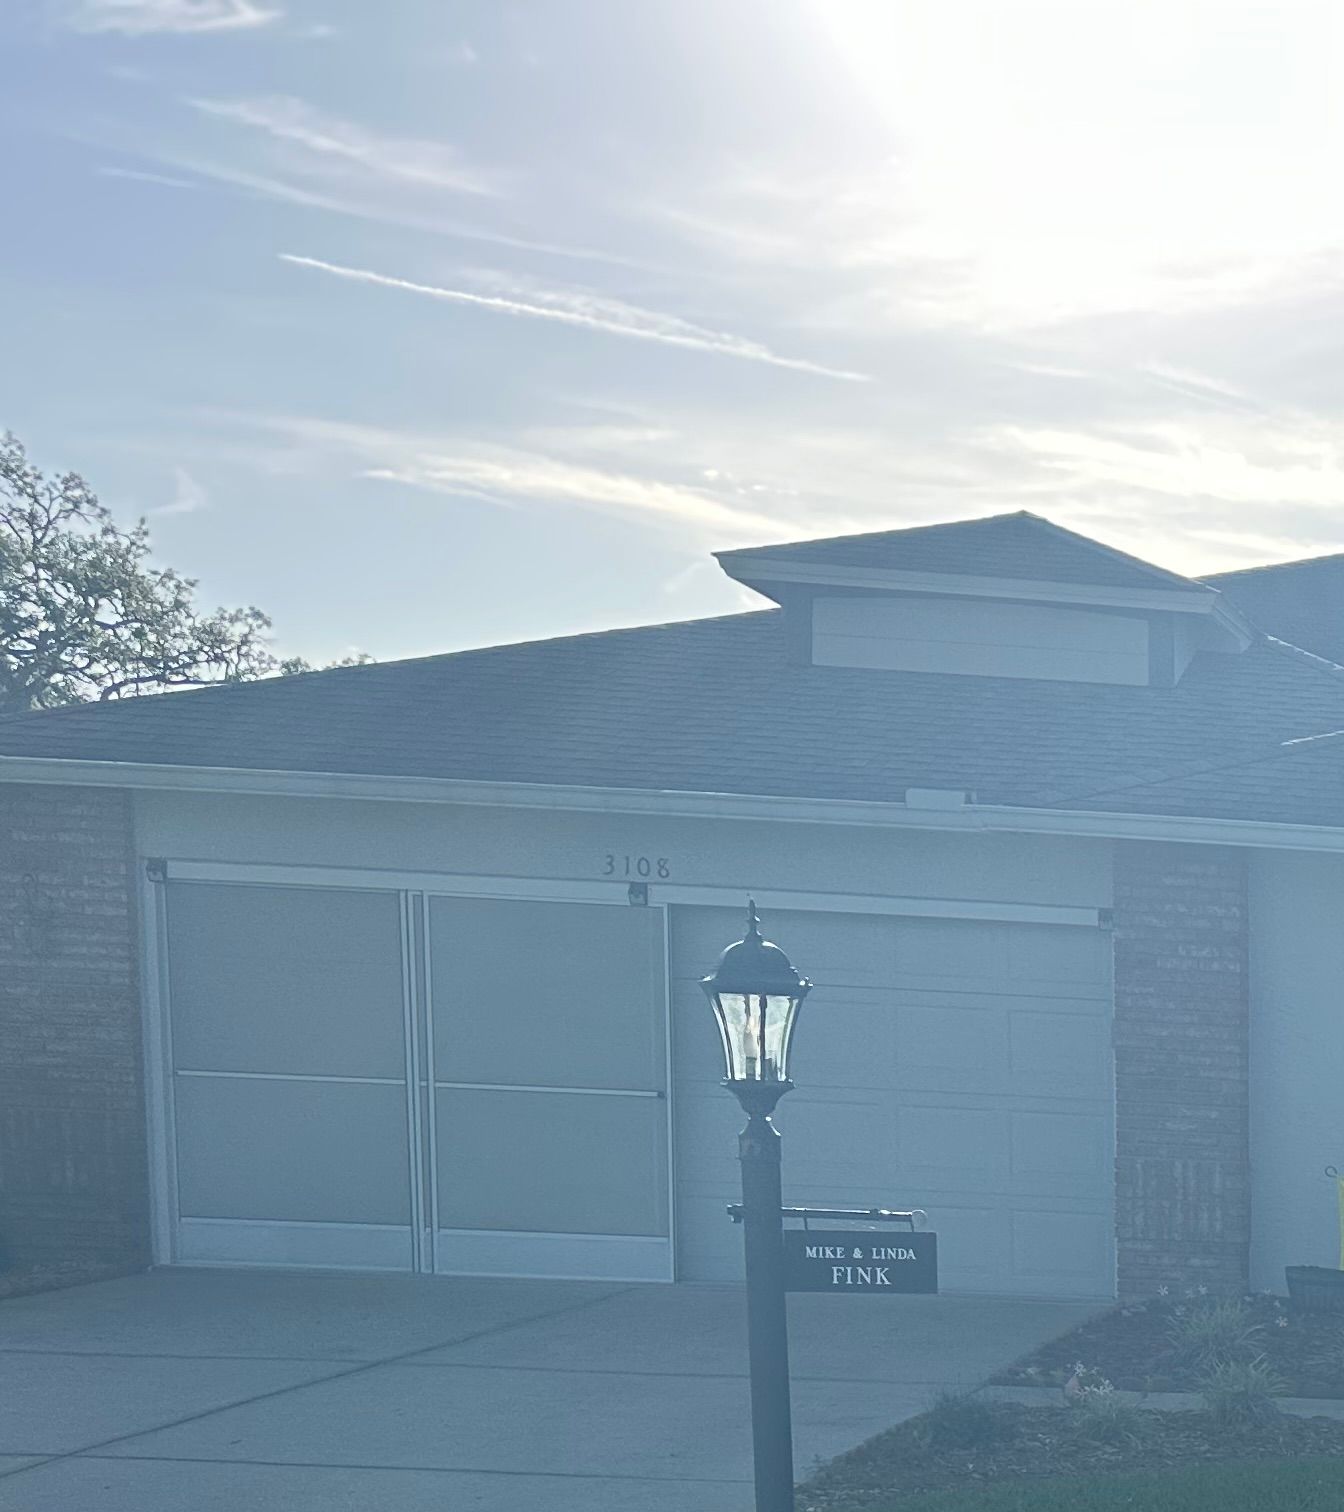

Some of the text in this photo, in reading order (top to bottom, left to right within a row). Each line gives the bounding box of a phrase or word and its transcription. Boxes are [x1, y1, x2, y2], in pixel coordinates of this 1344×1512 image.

[603, 855, 670, 878] 3108
[806, 1246, 917, 1260] MIKE & LINDA
[832, 1266, 892, 1285] FINK
